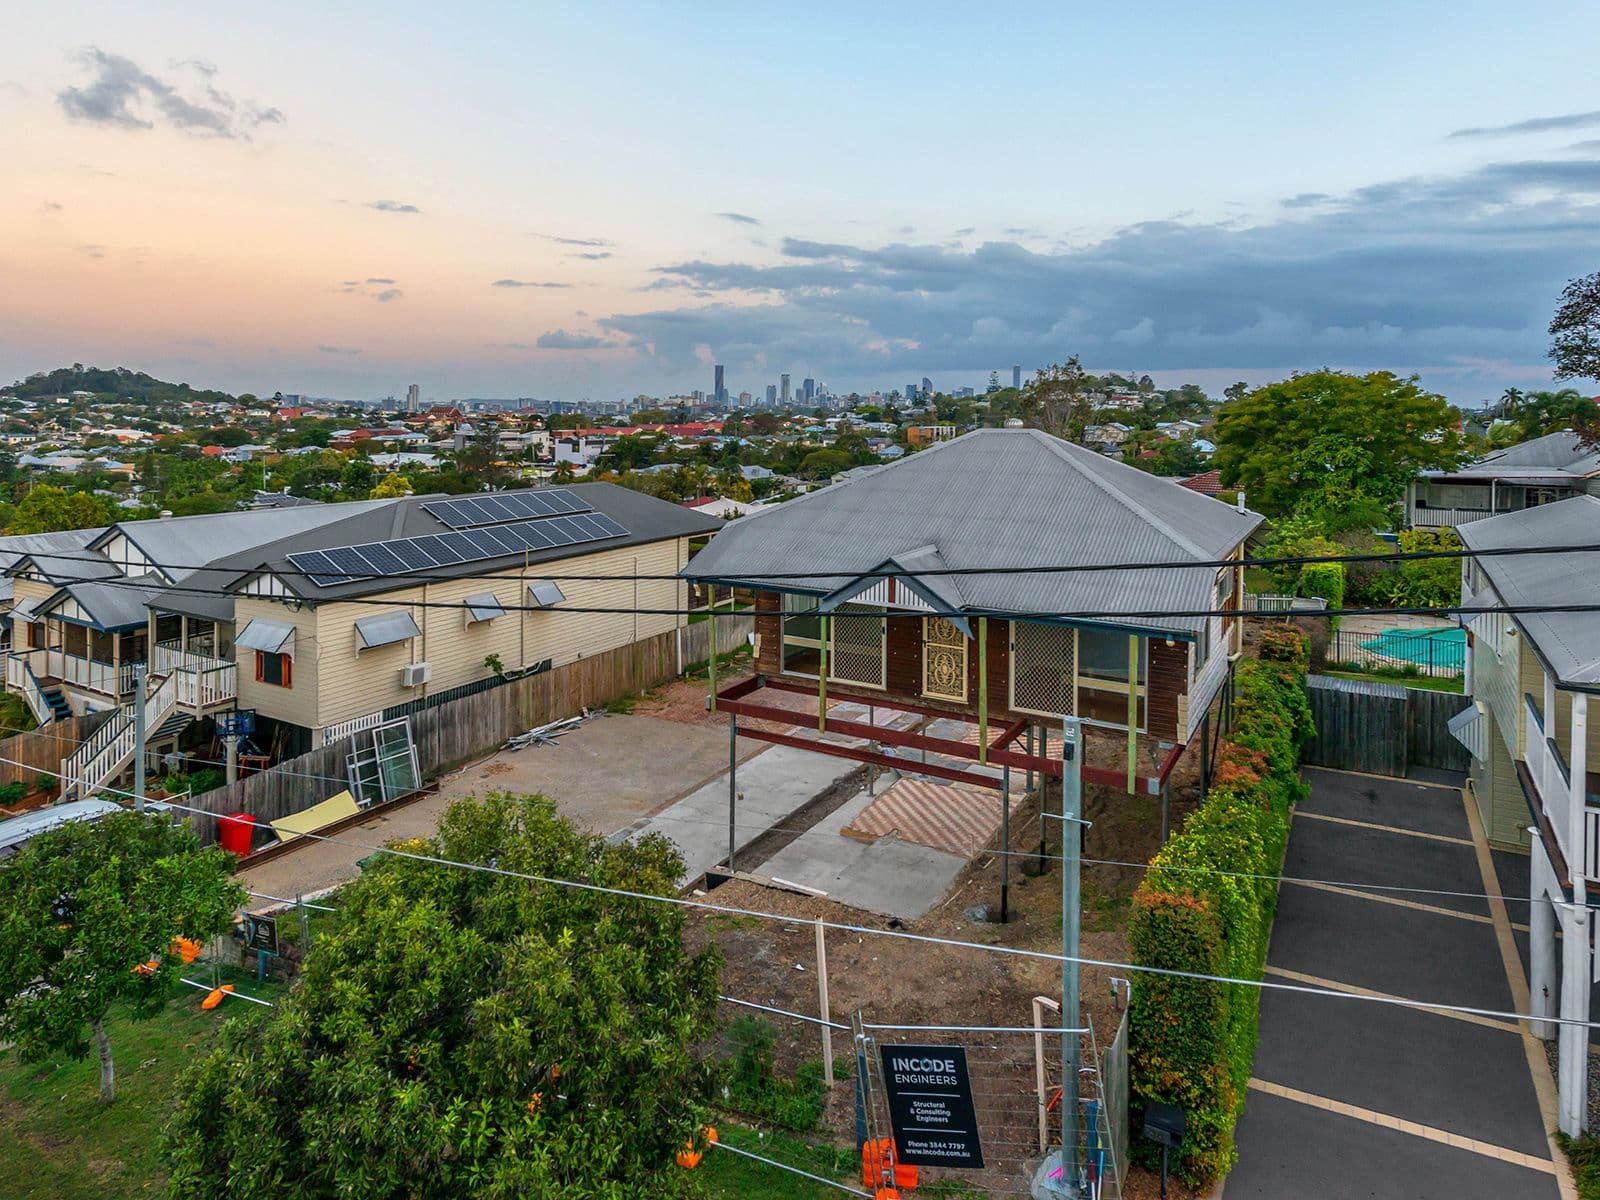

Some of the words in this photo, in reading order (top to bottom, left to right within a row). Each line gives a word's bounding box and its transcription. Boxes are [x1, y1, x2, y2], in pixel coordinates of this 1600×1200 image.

[892, 1058, 956, 1073] INCODE
[895, 1074, 958, 1085] ENGINEERS
[913, 1101, 946, 1109] Structural
[916, 1108, 951, 1117] Consulting
[916, 1115, 949, 1123] Engineers
[907, 1140, 928, 1148] Phone
[905, 1148, 971, 1158] www.incode.com.au
